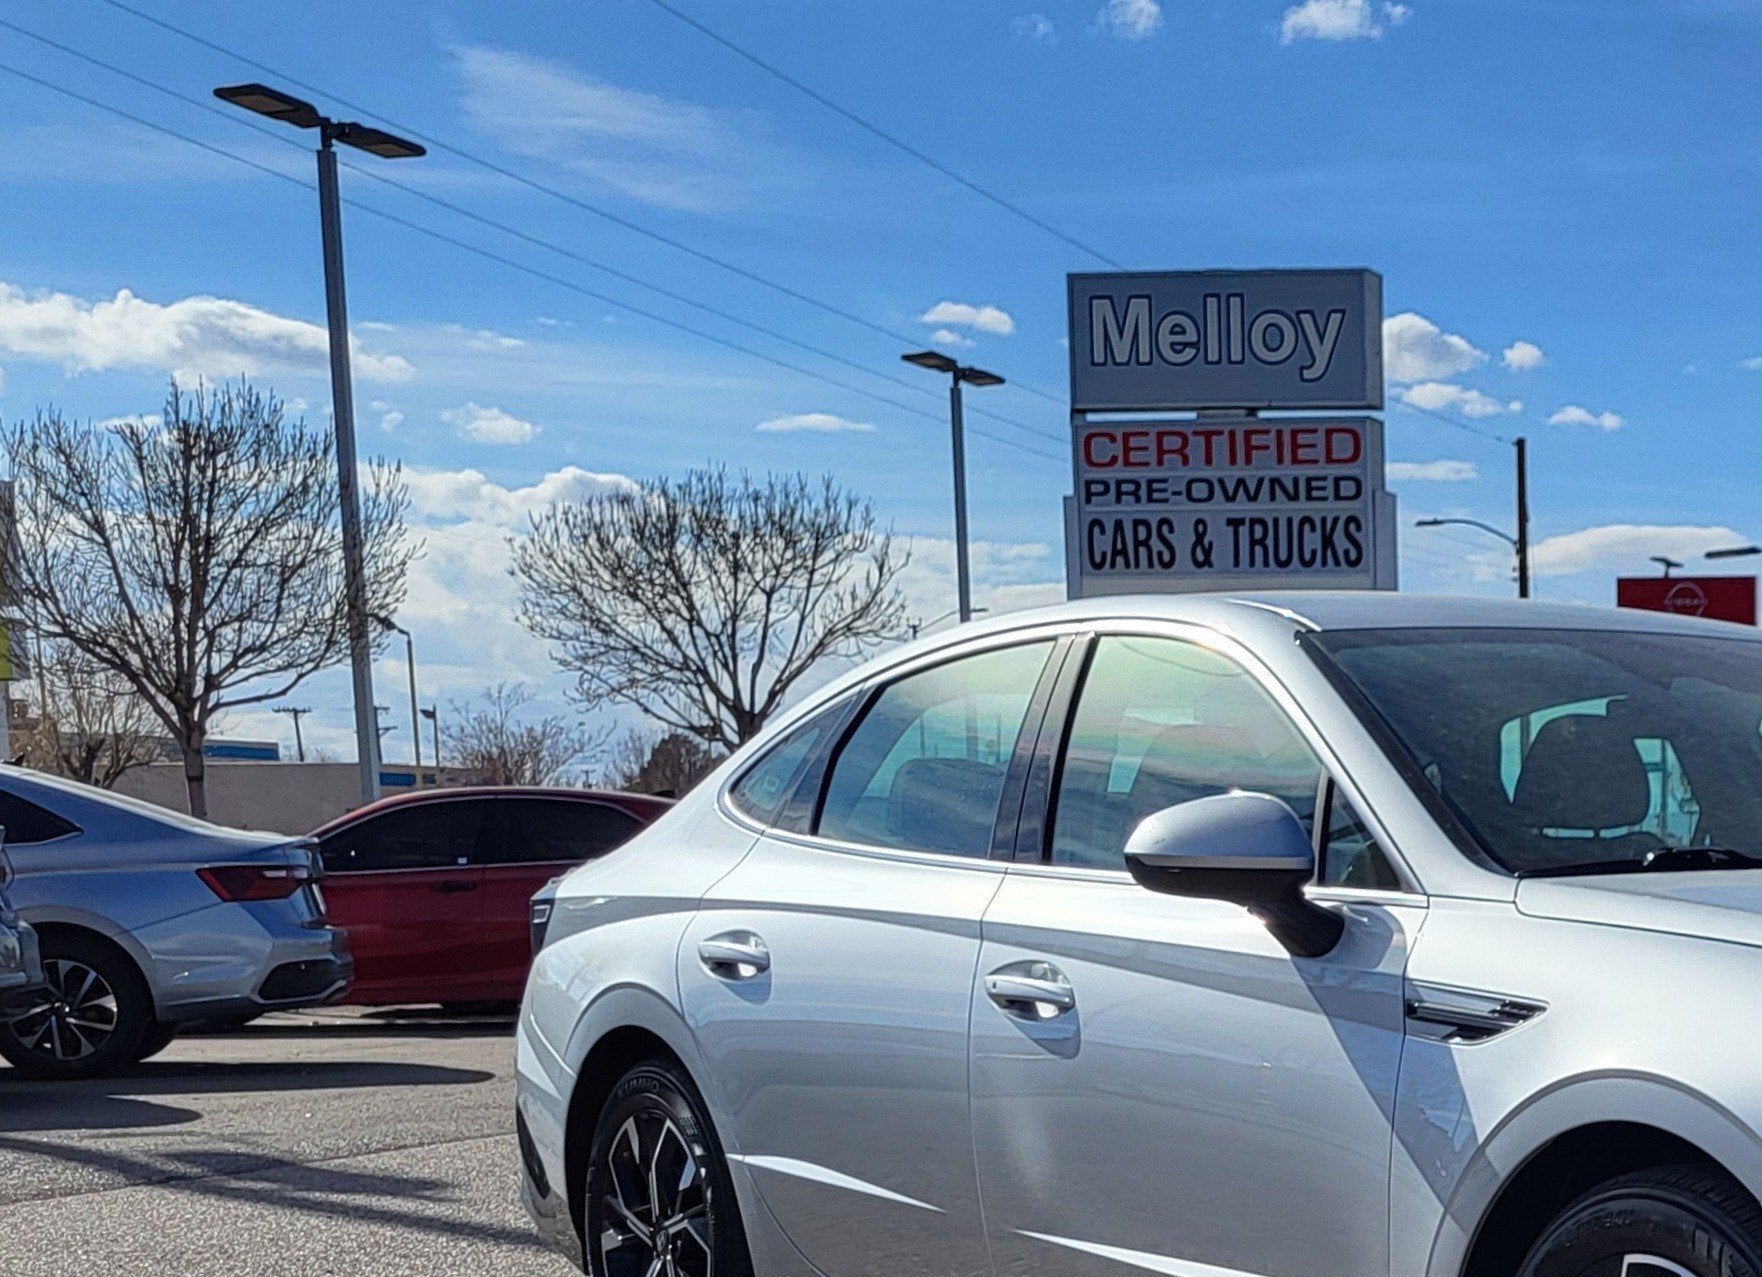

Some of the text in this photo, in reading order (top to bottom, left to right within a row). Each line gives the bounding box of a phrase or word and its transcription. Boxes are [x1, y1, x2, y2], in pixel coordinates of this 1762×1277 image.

[1089, 293, 1346, 383] Melloy
[1083, 428, 1362, 468] CERTIFIED
[1084, 476, 1363, 504] PRE-OWNED
[1087, 516, 1364, 570] CARS & TRUCKS
